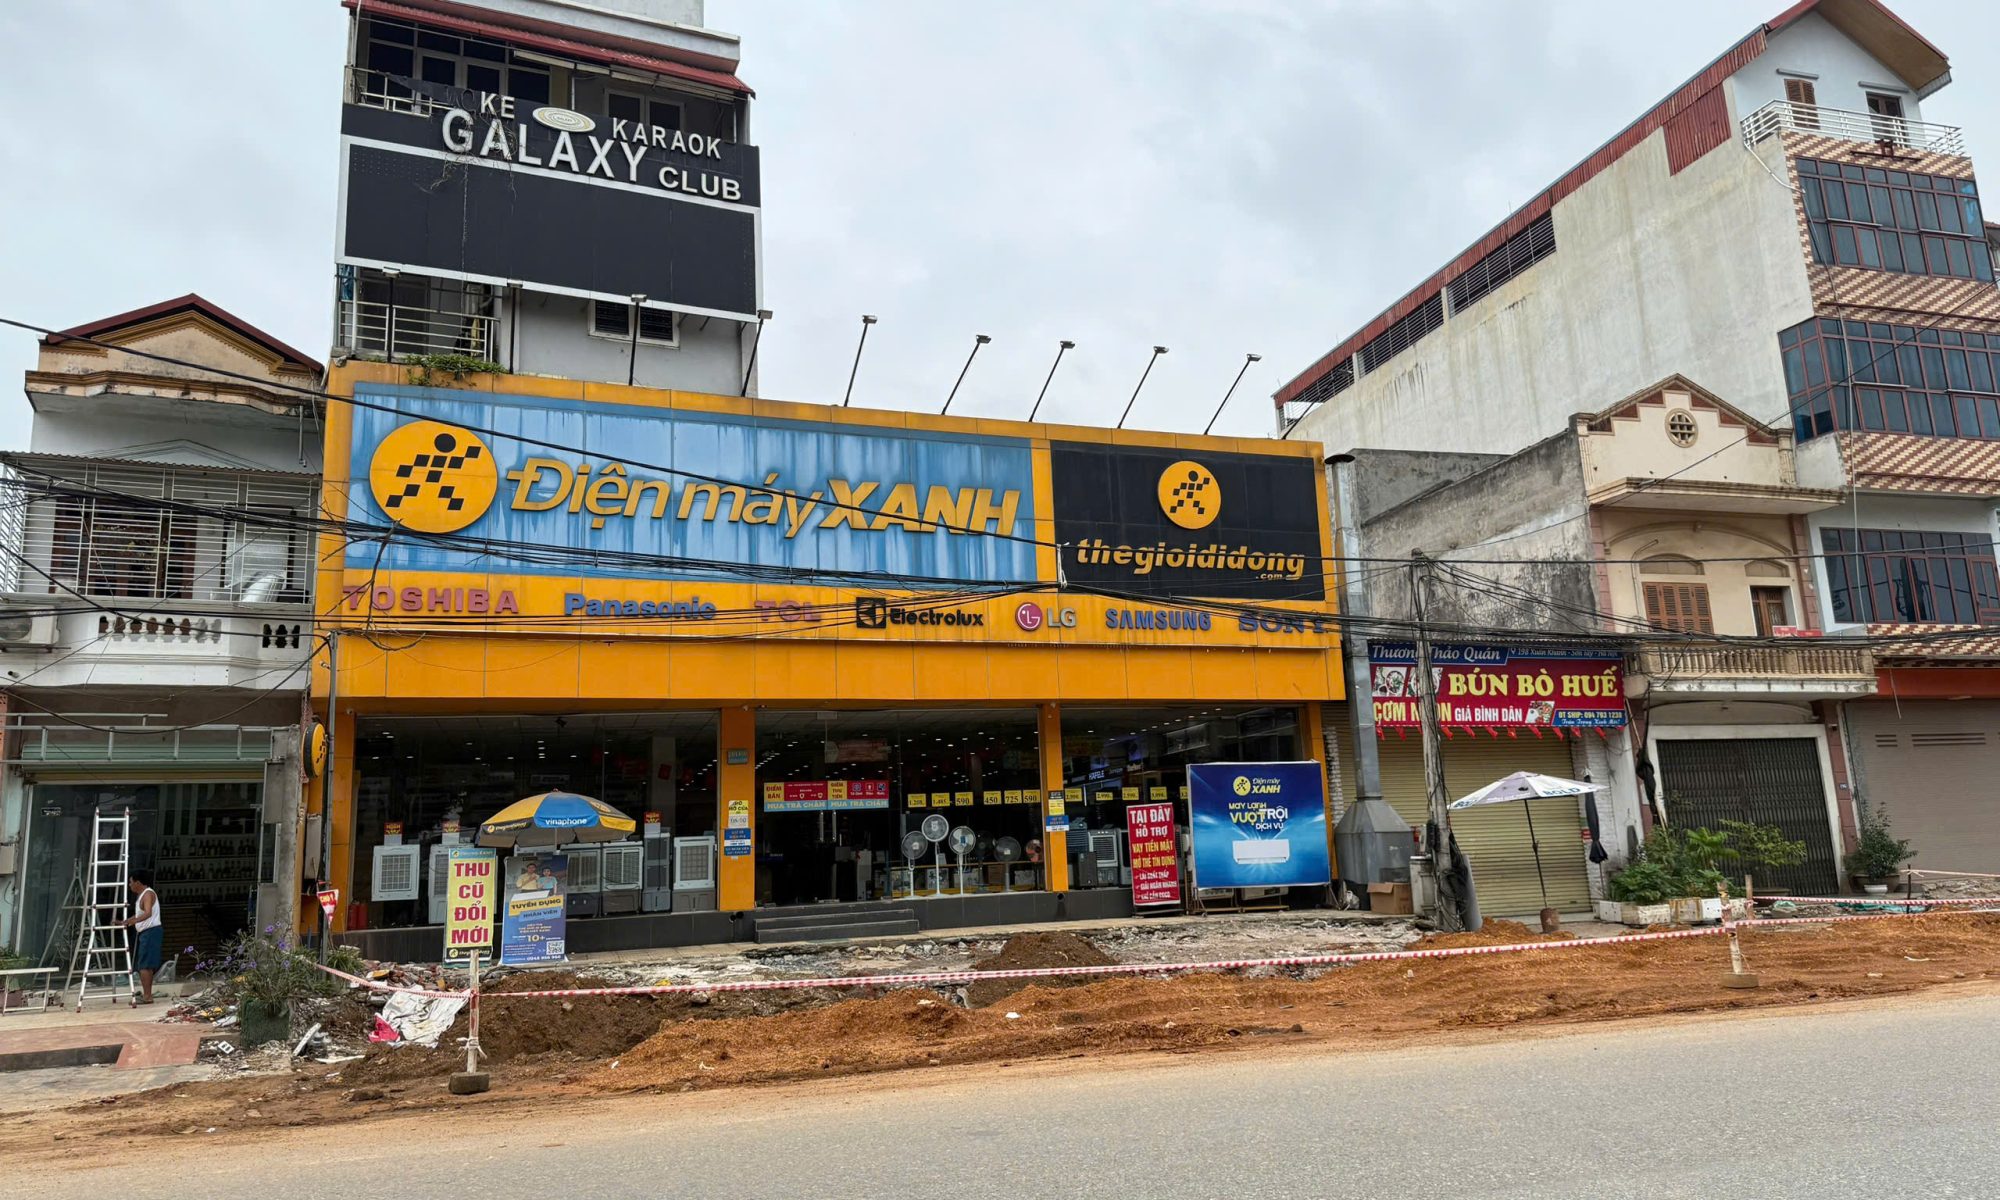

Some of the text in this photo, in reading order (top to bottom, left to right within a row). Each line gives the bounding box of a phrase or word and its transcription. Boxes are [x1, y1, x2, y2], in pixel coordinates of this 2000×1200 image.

[613, 117, 721, 160] KARAOK
[442, 108, 741, 200] GALAXY CLUB
[506, 457, 1020, 538] Điện máy XANH
[1077, 538, 1304, 580] thegioididong
[343, 585, 519, 614] TOSHIBA
[564, 592, 717, 620] Panasonic
[889, 608, 984, 627] Electrolux
[1047, 608, 1077, 627] LG
[1106, 608, 1211, 630] SAMSUNG
[1373, 645, 1419, 661] Thươn
[1464, 646, 1500, 662] Quán
[1448, 665, 1618, 697] BÚN BÒ HUẾ
[1373, 700, 1406, 722] CƠM
[1474, 704, 1499, 722] BÌNH
[1502, 705, 1522, 722] DÂN
[984, 796, 998, 804] 450
[1251, 785, 1281, 794] XANH
[545, 818, 587, 826] vinaphone
[1130, 806, 1171, 827] TẠI ĐÂY
[1150, 825, 1168, 838] TRỢ
[454, 862, 490, 877] THU
[459, 881, 485, 899] CŨ
[454, 900, 487, 922] ĐỔI
[451, 926, 489, 944] MỚI
